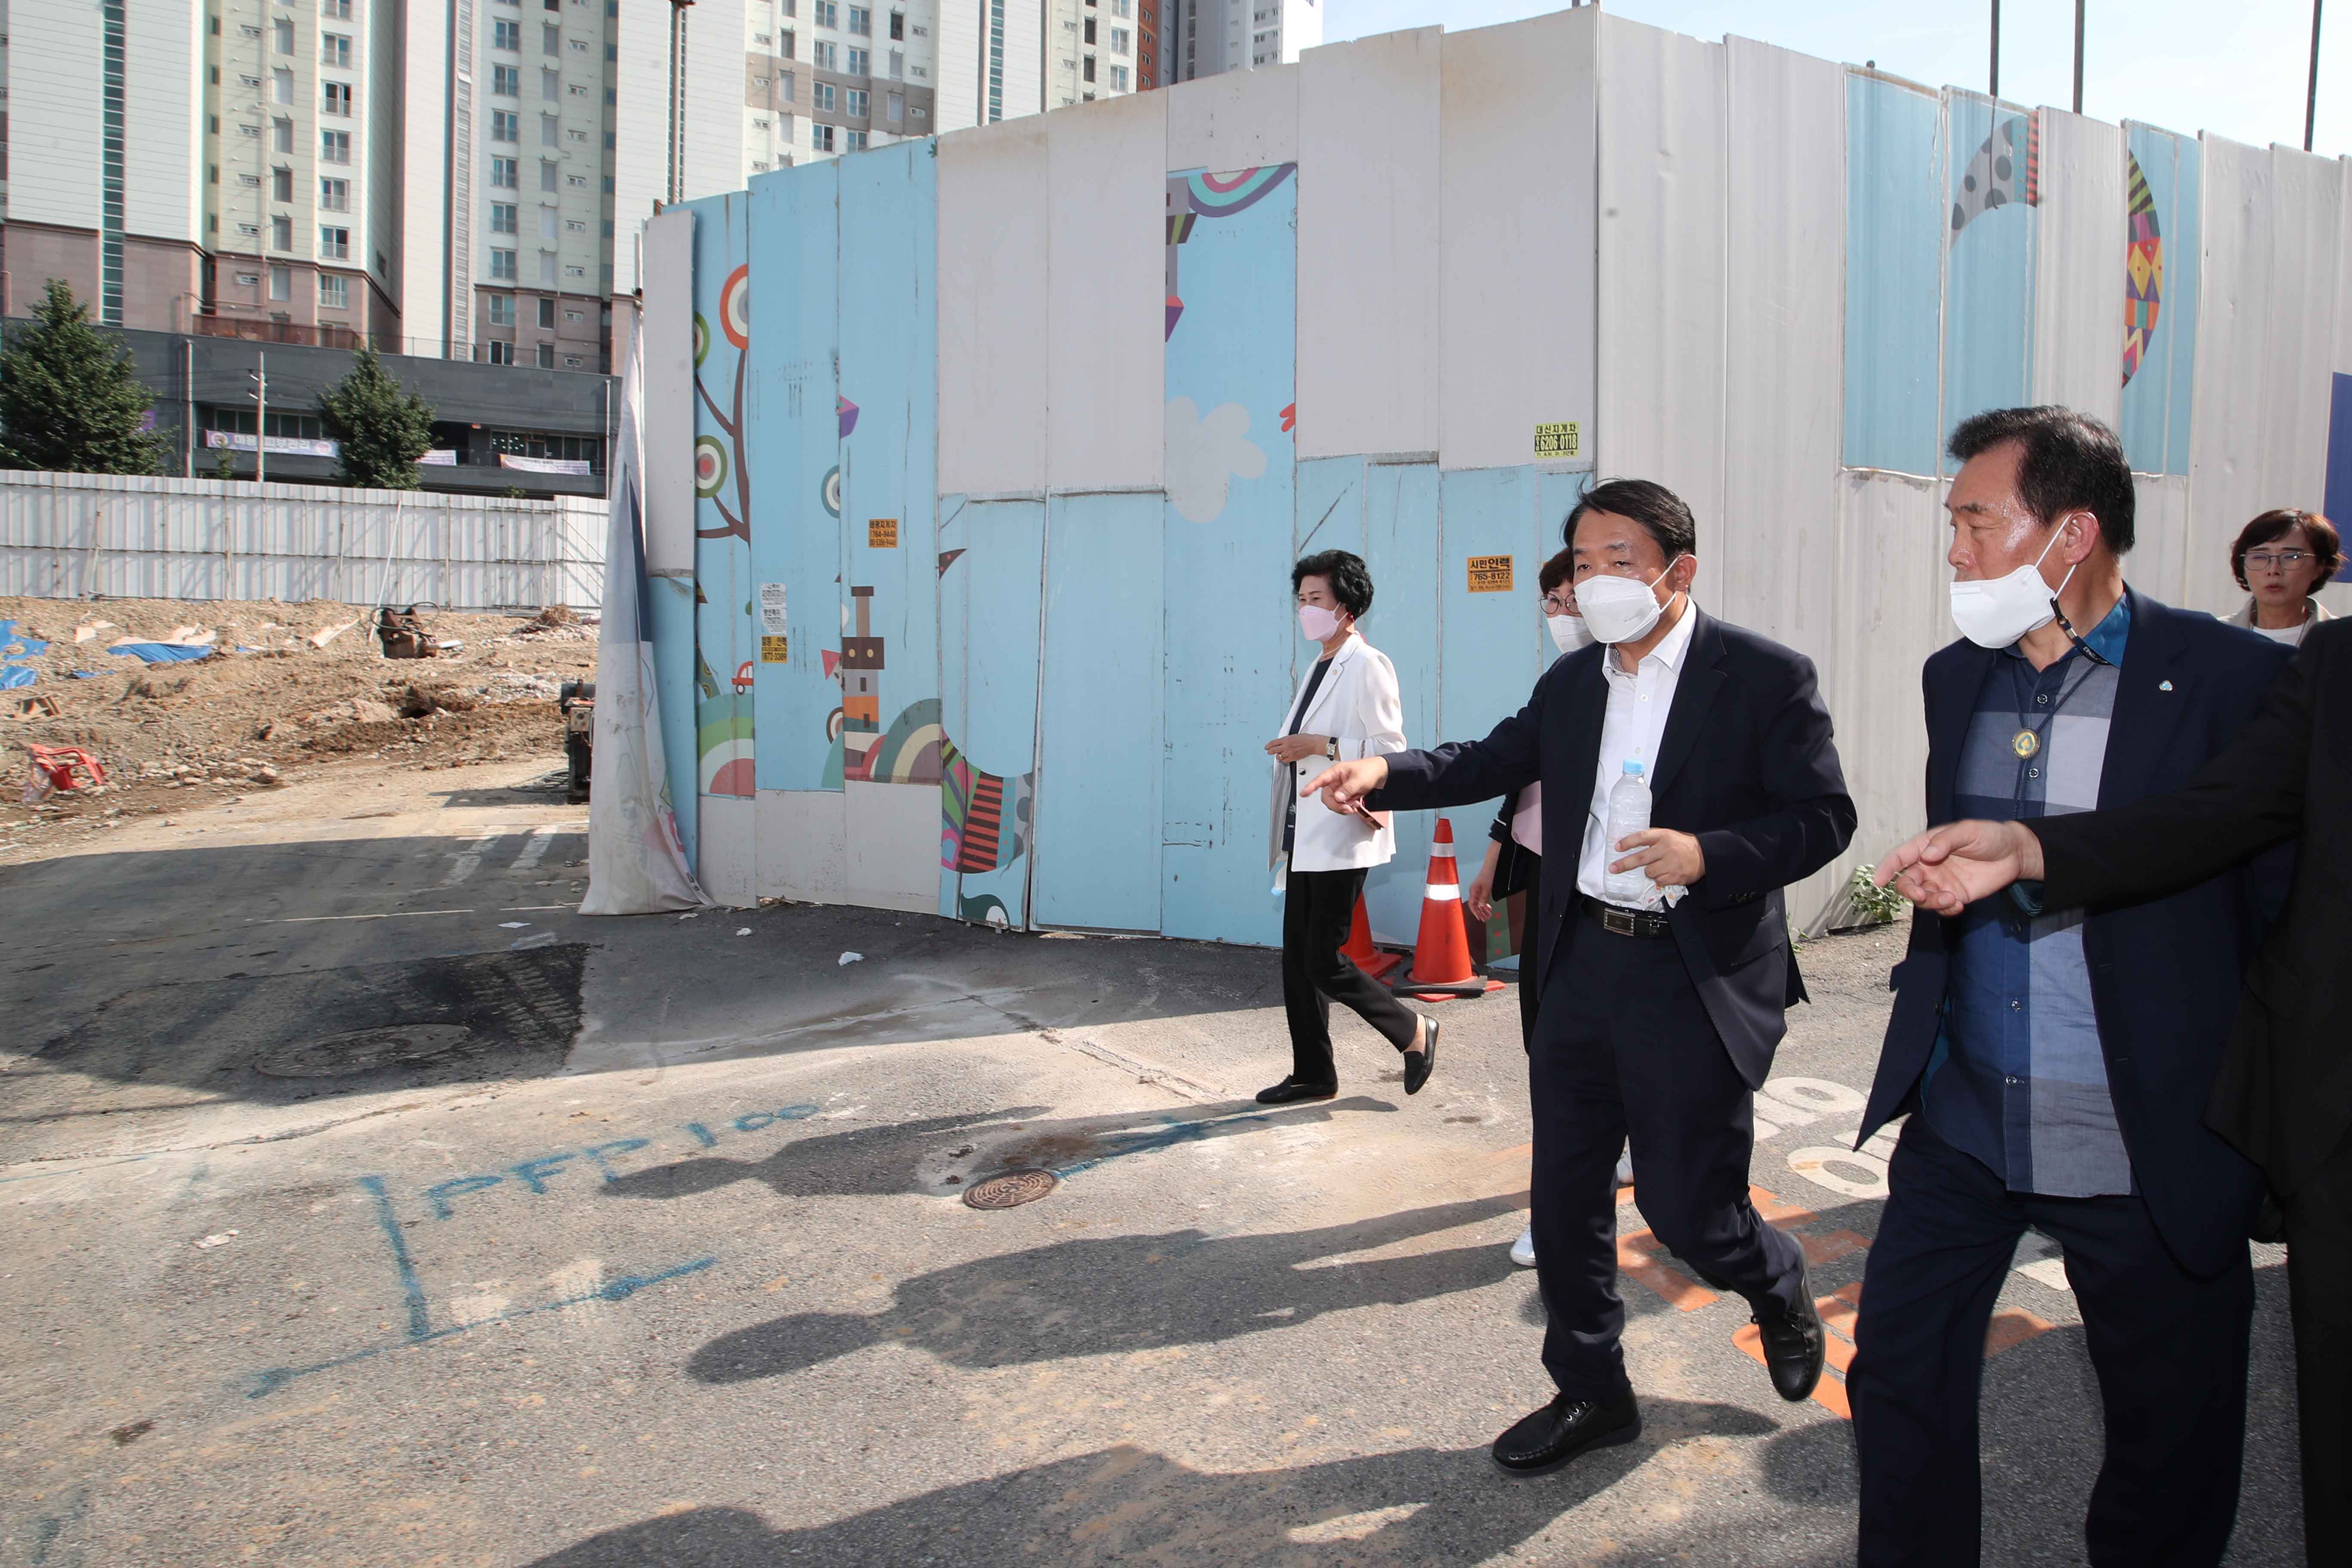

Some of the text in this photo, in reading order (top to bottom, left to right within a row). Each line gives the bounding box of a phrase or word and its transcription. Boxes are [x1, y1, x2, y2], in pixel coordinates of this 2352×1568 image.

[1536, 423, 1576, 434] 대신지게차
[1540, 434, 1577, 450] 6206-0118
[1470, 557, 1510, 569] 시민인력
[1473, 572, 1510, 580] 765-8122
